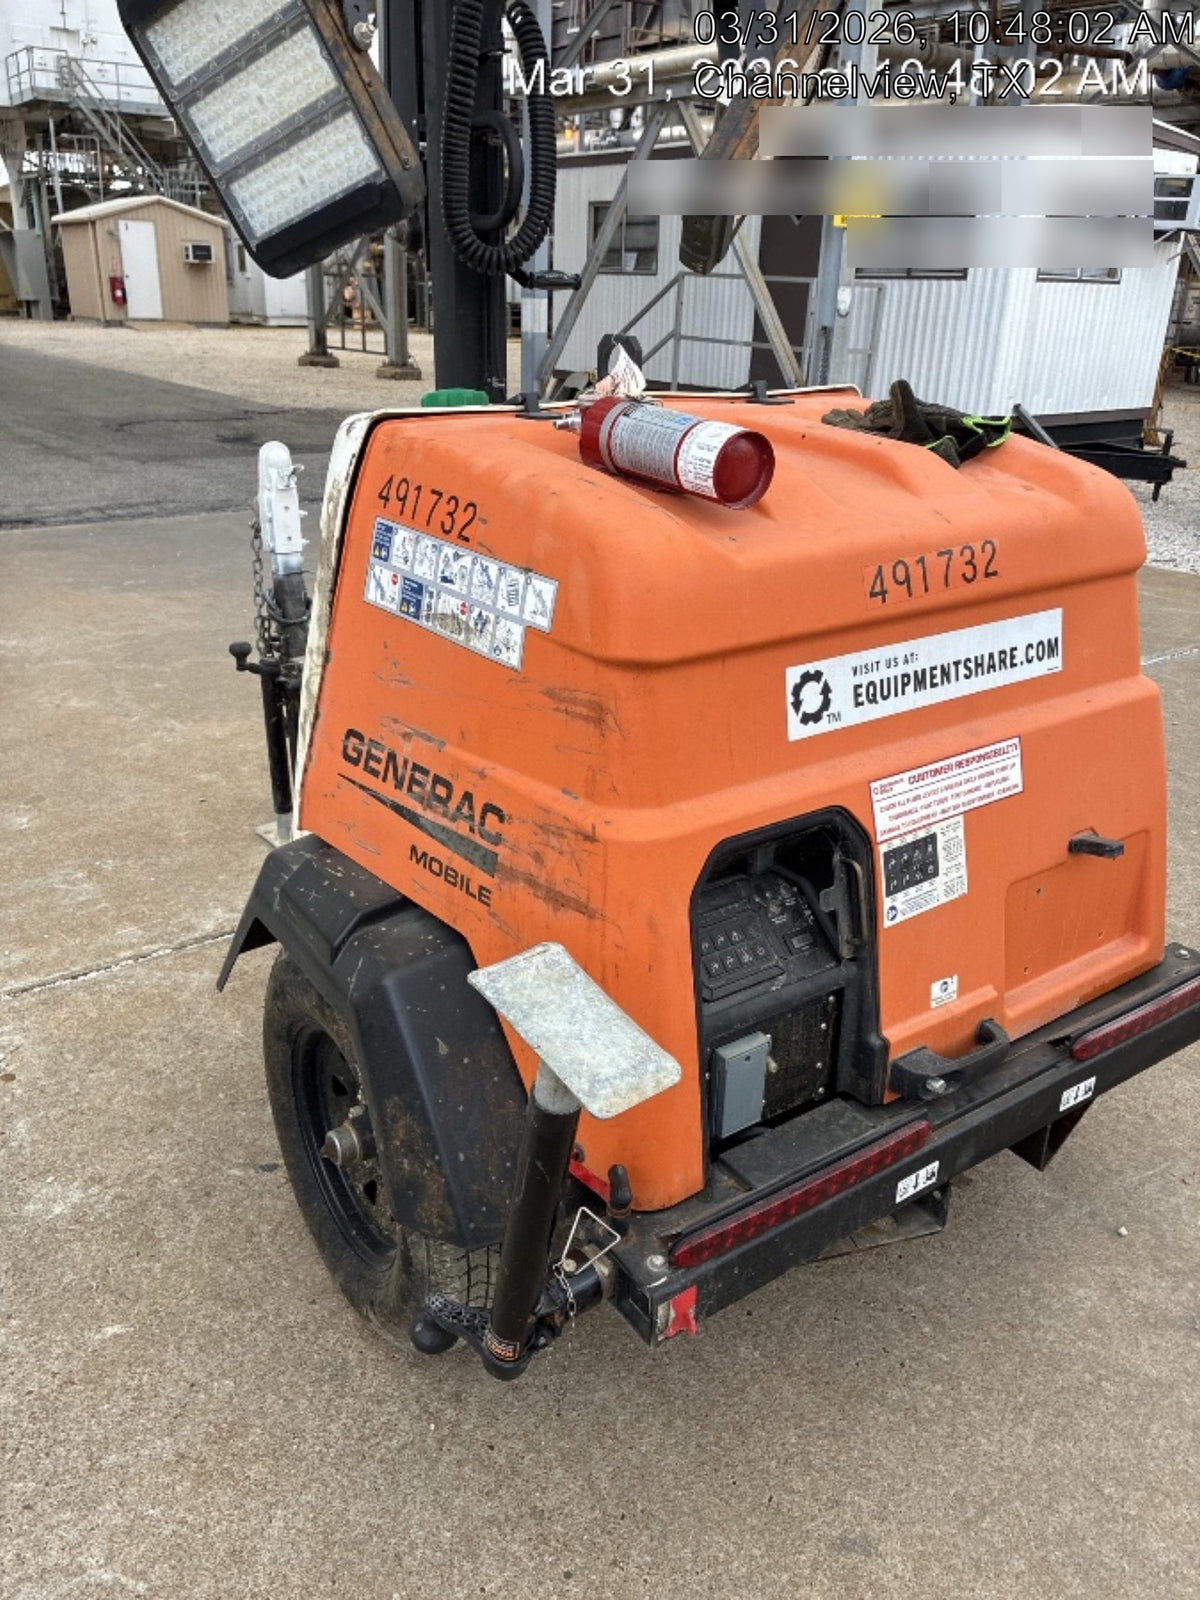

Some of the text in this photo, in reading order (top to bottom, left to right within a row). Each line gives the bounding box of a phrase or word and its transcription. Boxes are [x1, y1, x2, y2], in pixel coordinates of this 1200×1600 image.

[378, 474, 478, 543] 491732
[868, 539, 999, 604] 491732
[851, 660, 881, 677] VISIT
[884, 656, 899, 669] US
[852, 636, 1060, 708] EQUIPMENTSHARE.COM
[341, 727, 507, 848] GENERAC
[408, 843, 493, 907] MOBILE
